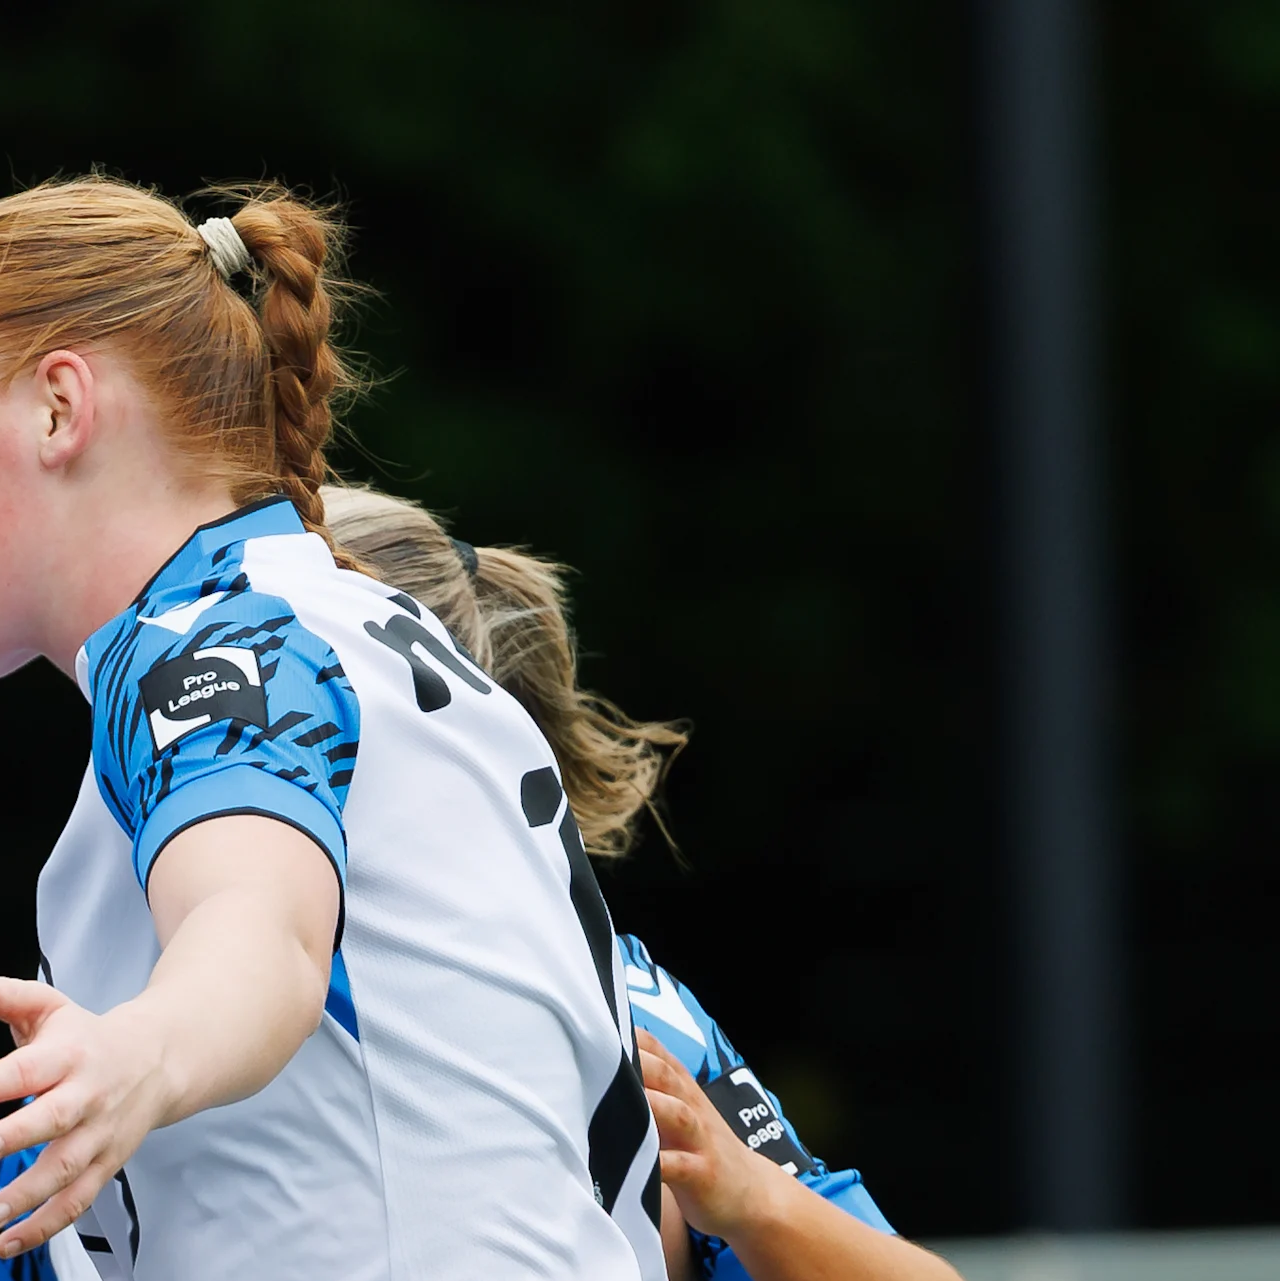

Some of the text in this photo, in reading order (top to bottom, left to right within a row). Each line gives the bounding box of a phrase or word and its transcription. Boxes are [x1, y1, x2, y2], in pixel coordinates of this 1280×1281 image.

[182, 670, 217, 691] Pro
[167, 681, 241, 713] League
[738, 1102, 769, 1128] Pro
[746, 1119, 785, 1151] eag
